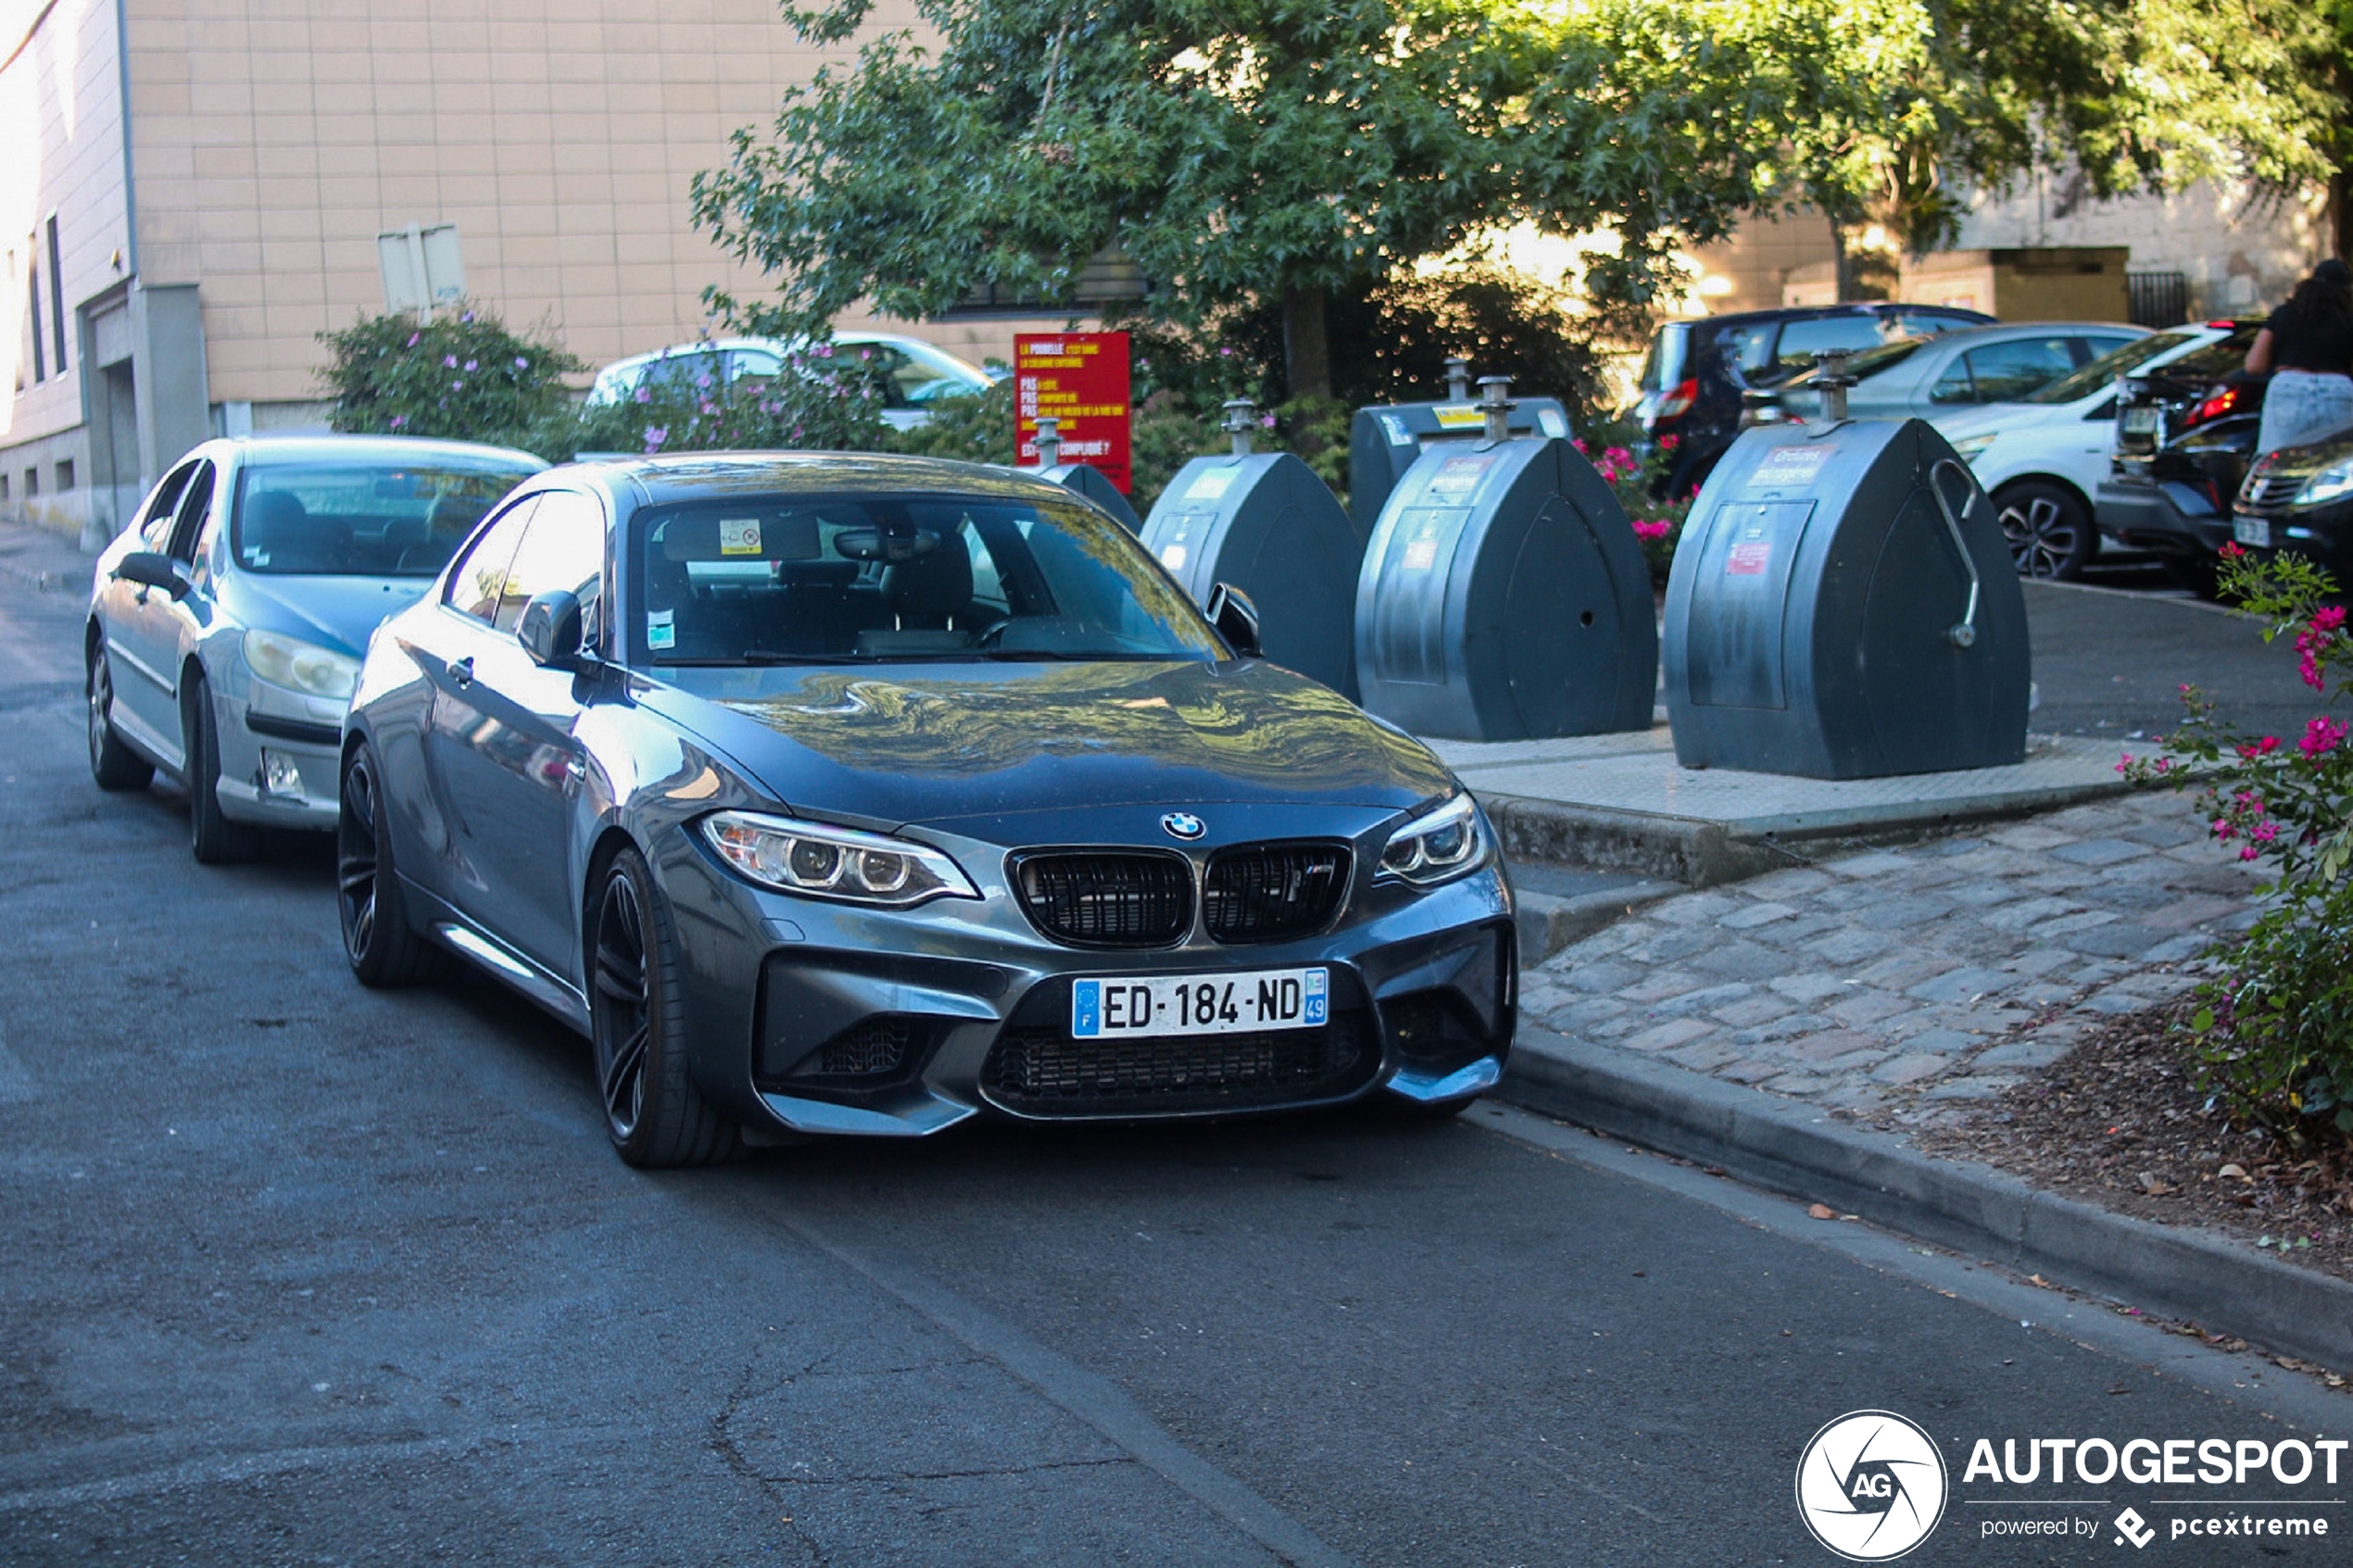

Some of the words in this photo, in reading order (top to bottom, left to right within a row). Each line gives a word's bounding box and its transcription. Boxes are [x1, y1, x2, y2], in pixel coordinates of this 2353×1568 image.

[1030, 343, 1063, 355] POUBELLE
[1021, 377, 1037, 391] PAS
[1021, 392, 1037, 404] PAS
[1021, 405, 1037, 417] PAS
[1060, 440, 1102, 456] COMPLIQUÉ
[1082, 1014, 1091, 1027] F
[1104, 978, 1301, 1029] ED-184-ND
[1306, 999, 1325, 1019] 49
